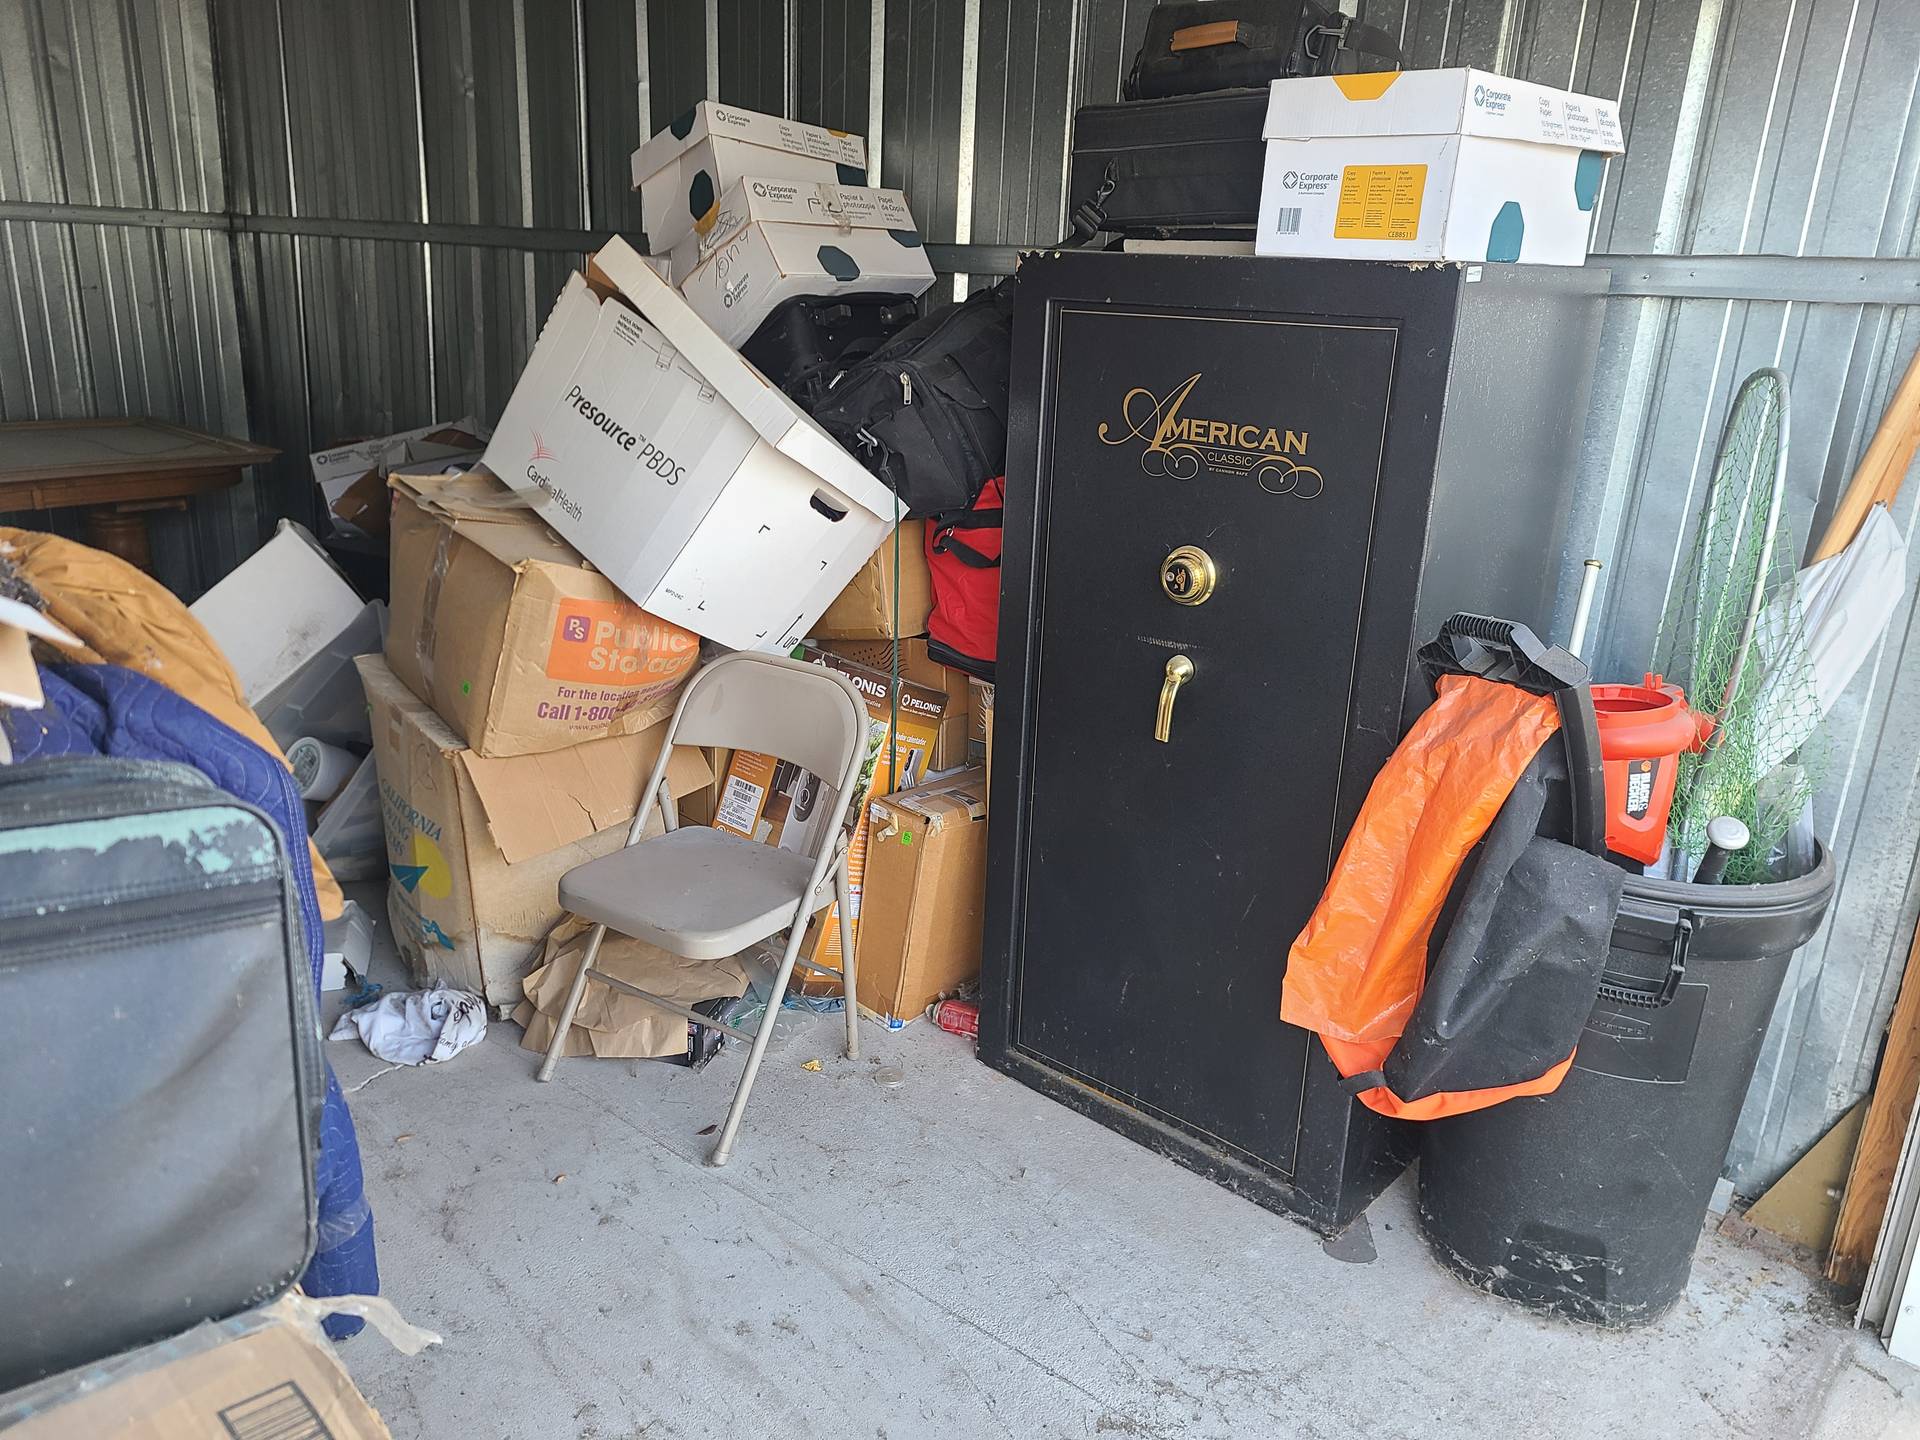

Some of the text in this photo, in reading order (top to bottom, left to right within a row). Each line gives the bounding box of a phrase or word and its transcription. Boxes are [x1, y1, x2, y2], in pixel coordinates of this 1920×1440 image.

[1486, 88, 1511, 101] Corporate
[1485, 98, 1506, 111] Express
[726, 112, 750, 124] Corporate
[1300, 172, 1339, 183] Corporate
[766, 184, 798, 195] Corporate
[1298, 181, 1327, 191] Express
[768, 191, 793, 201] Express
[565, 385, 637, 451] Presource
[1098, 372, 1309, 456] AMERICAN
[637, 442, 686, 486] PBDS
[1207, 451, 1252, 466] CLASSIC
[594, 620, 691, 653] Public
[782, 635, 799, 650] UP
[588, 645, 691, 675] Storage
[557, 686, 577, 699] For
[578, 688, 597, 701] the
[600, 689, 641, 702] location
[537, 702, 571, 721] Call
[910, 698, 942, 714] PELONIS
